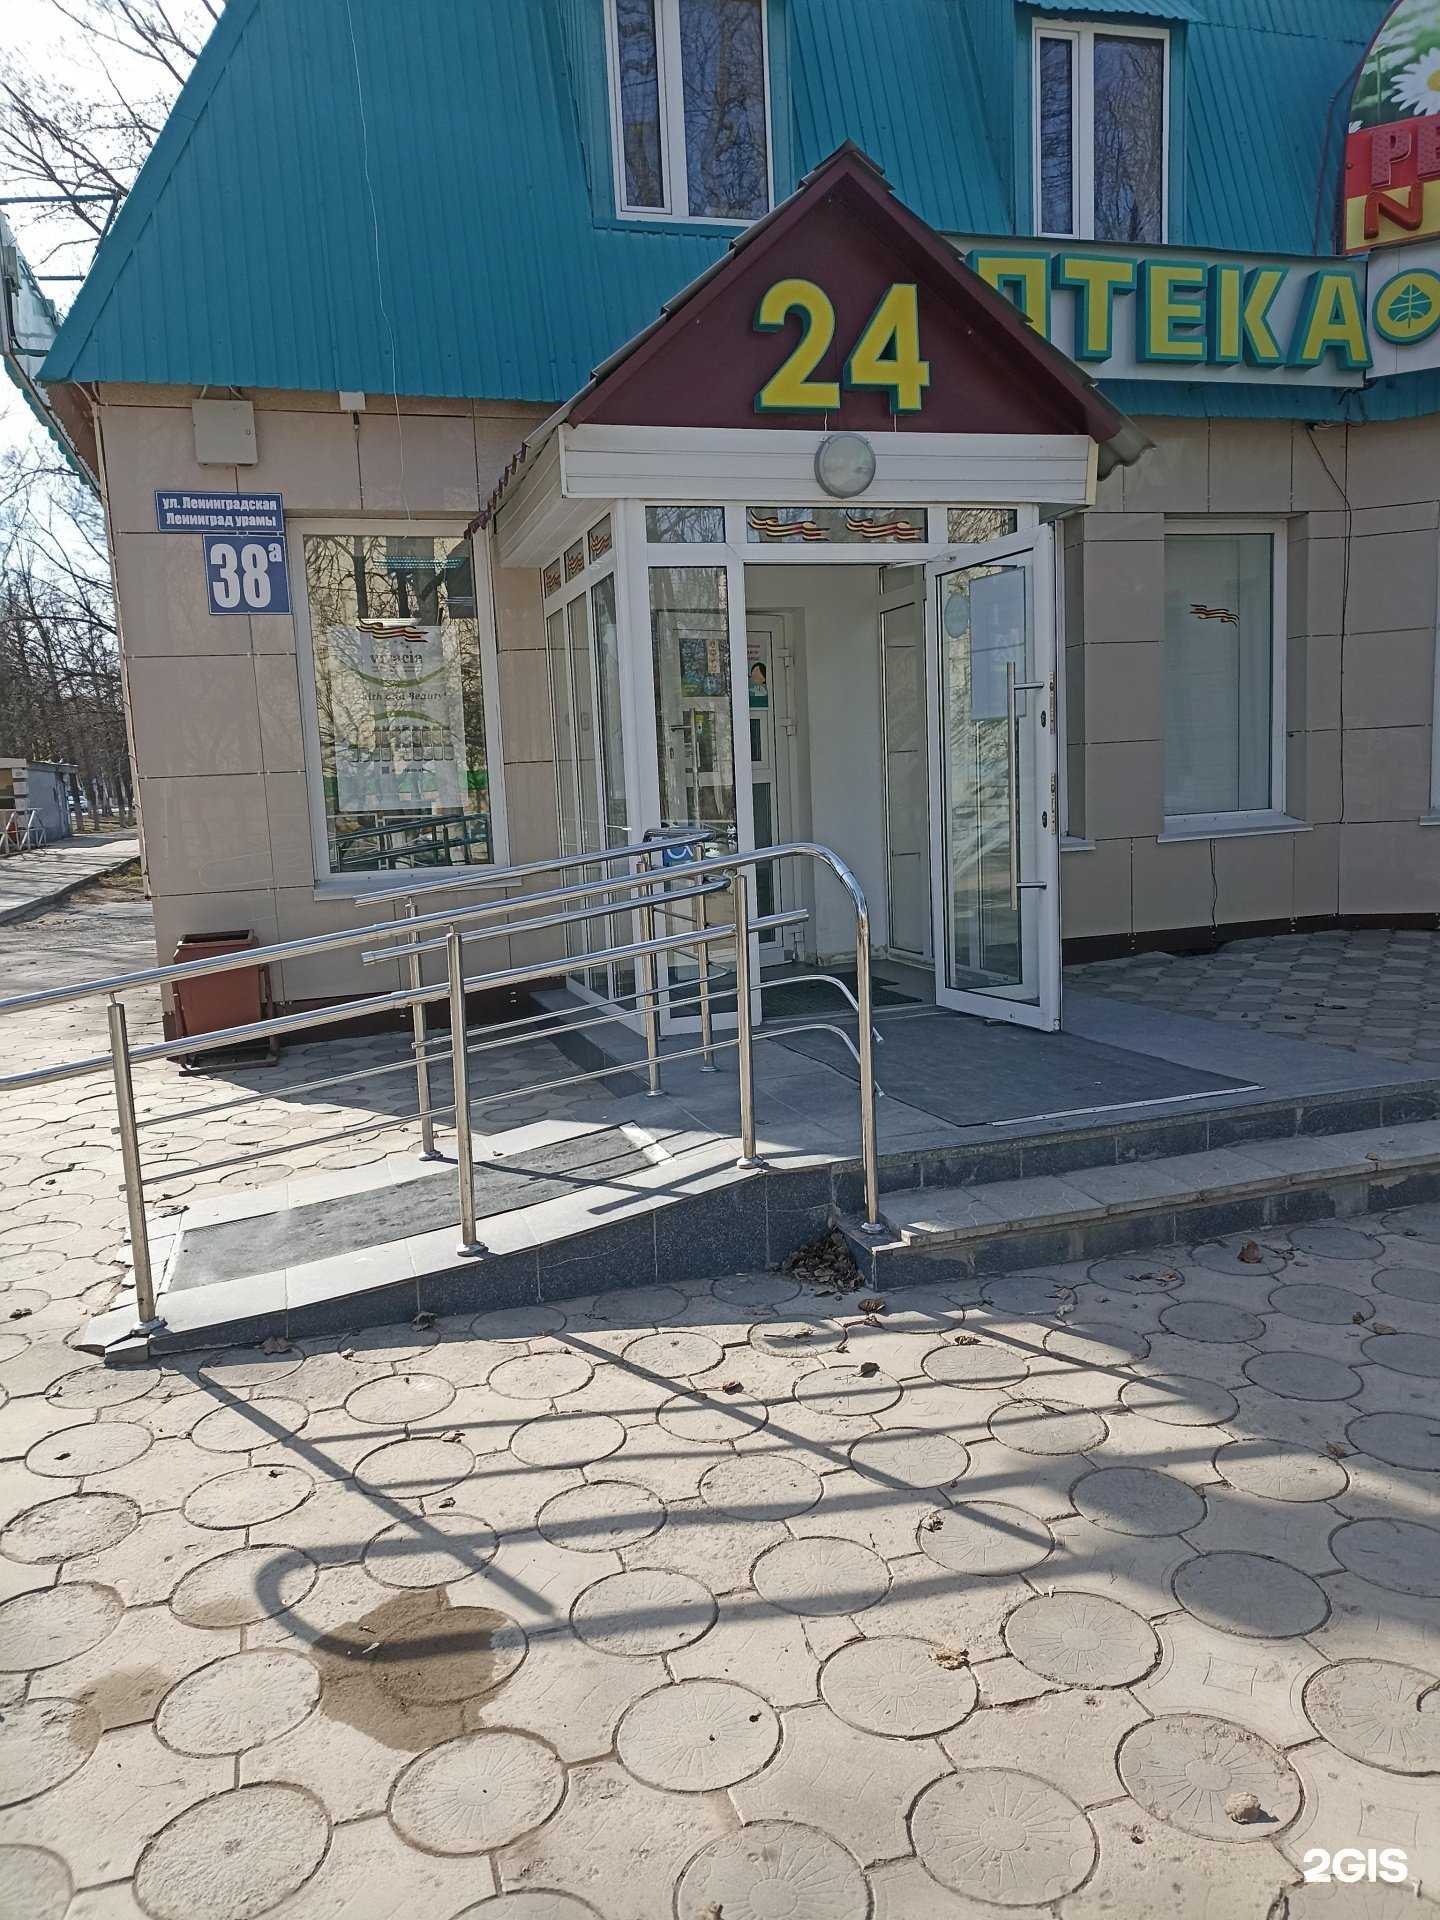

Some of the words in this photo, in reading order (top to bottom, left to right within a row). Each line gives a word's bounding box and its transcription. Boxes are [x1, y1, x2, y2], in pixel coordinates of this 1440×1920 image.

[969, 250, 1374, 369] ПТЕКА
[753, 278, 930, 414] 24
[162, 497, 181, 510] ул.
[182, 496, 277, 511] Ленинградская
[165, 512, 234, 527] Ленинград
[234, 514, 277, 528] урамы
